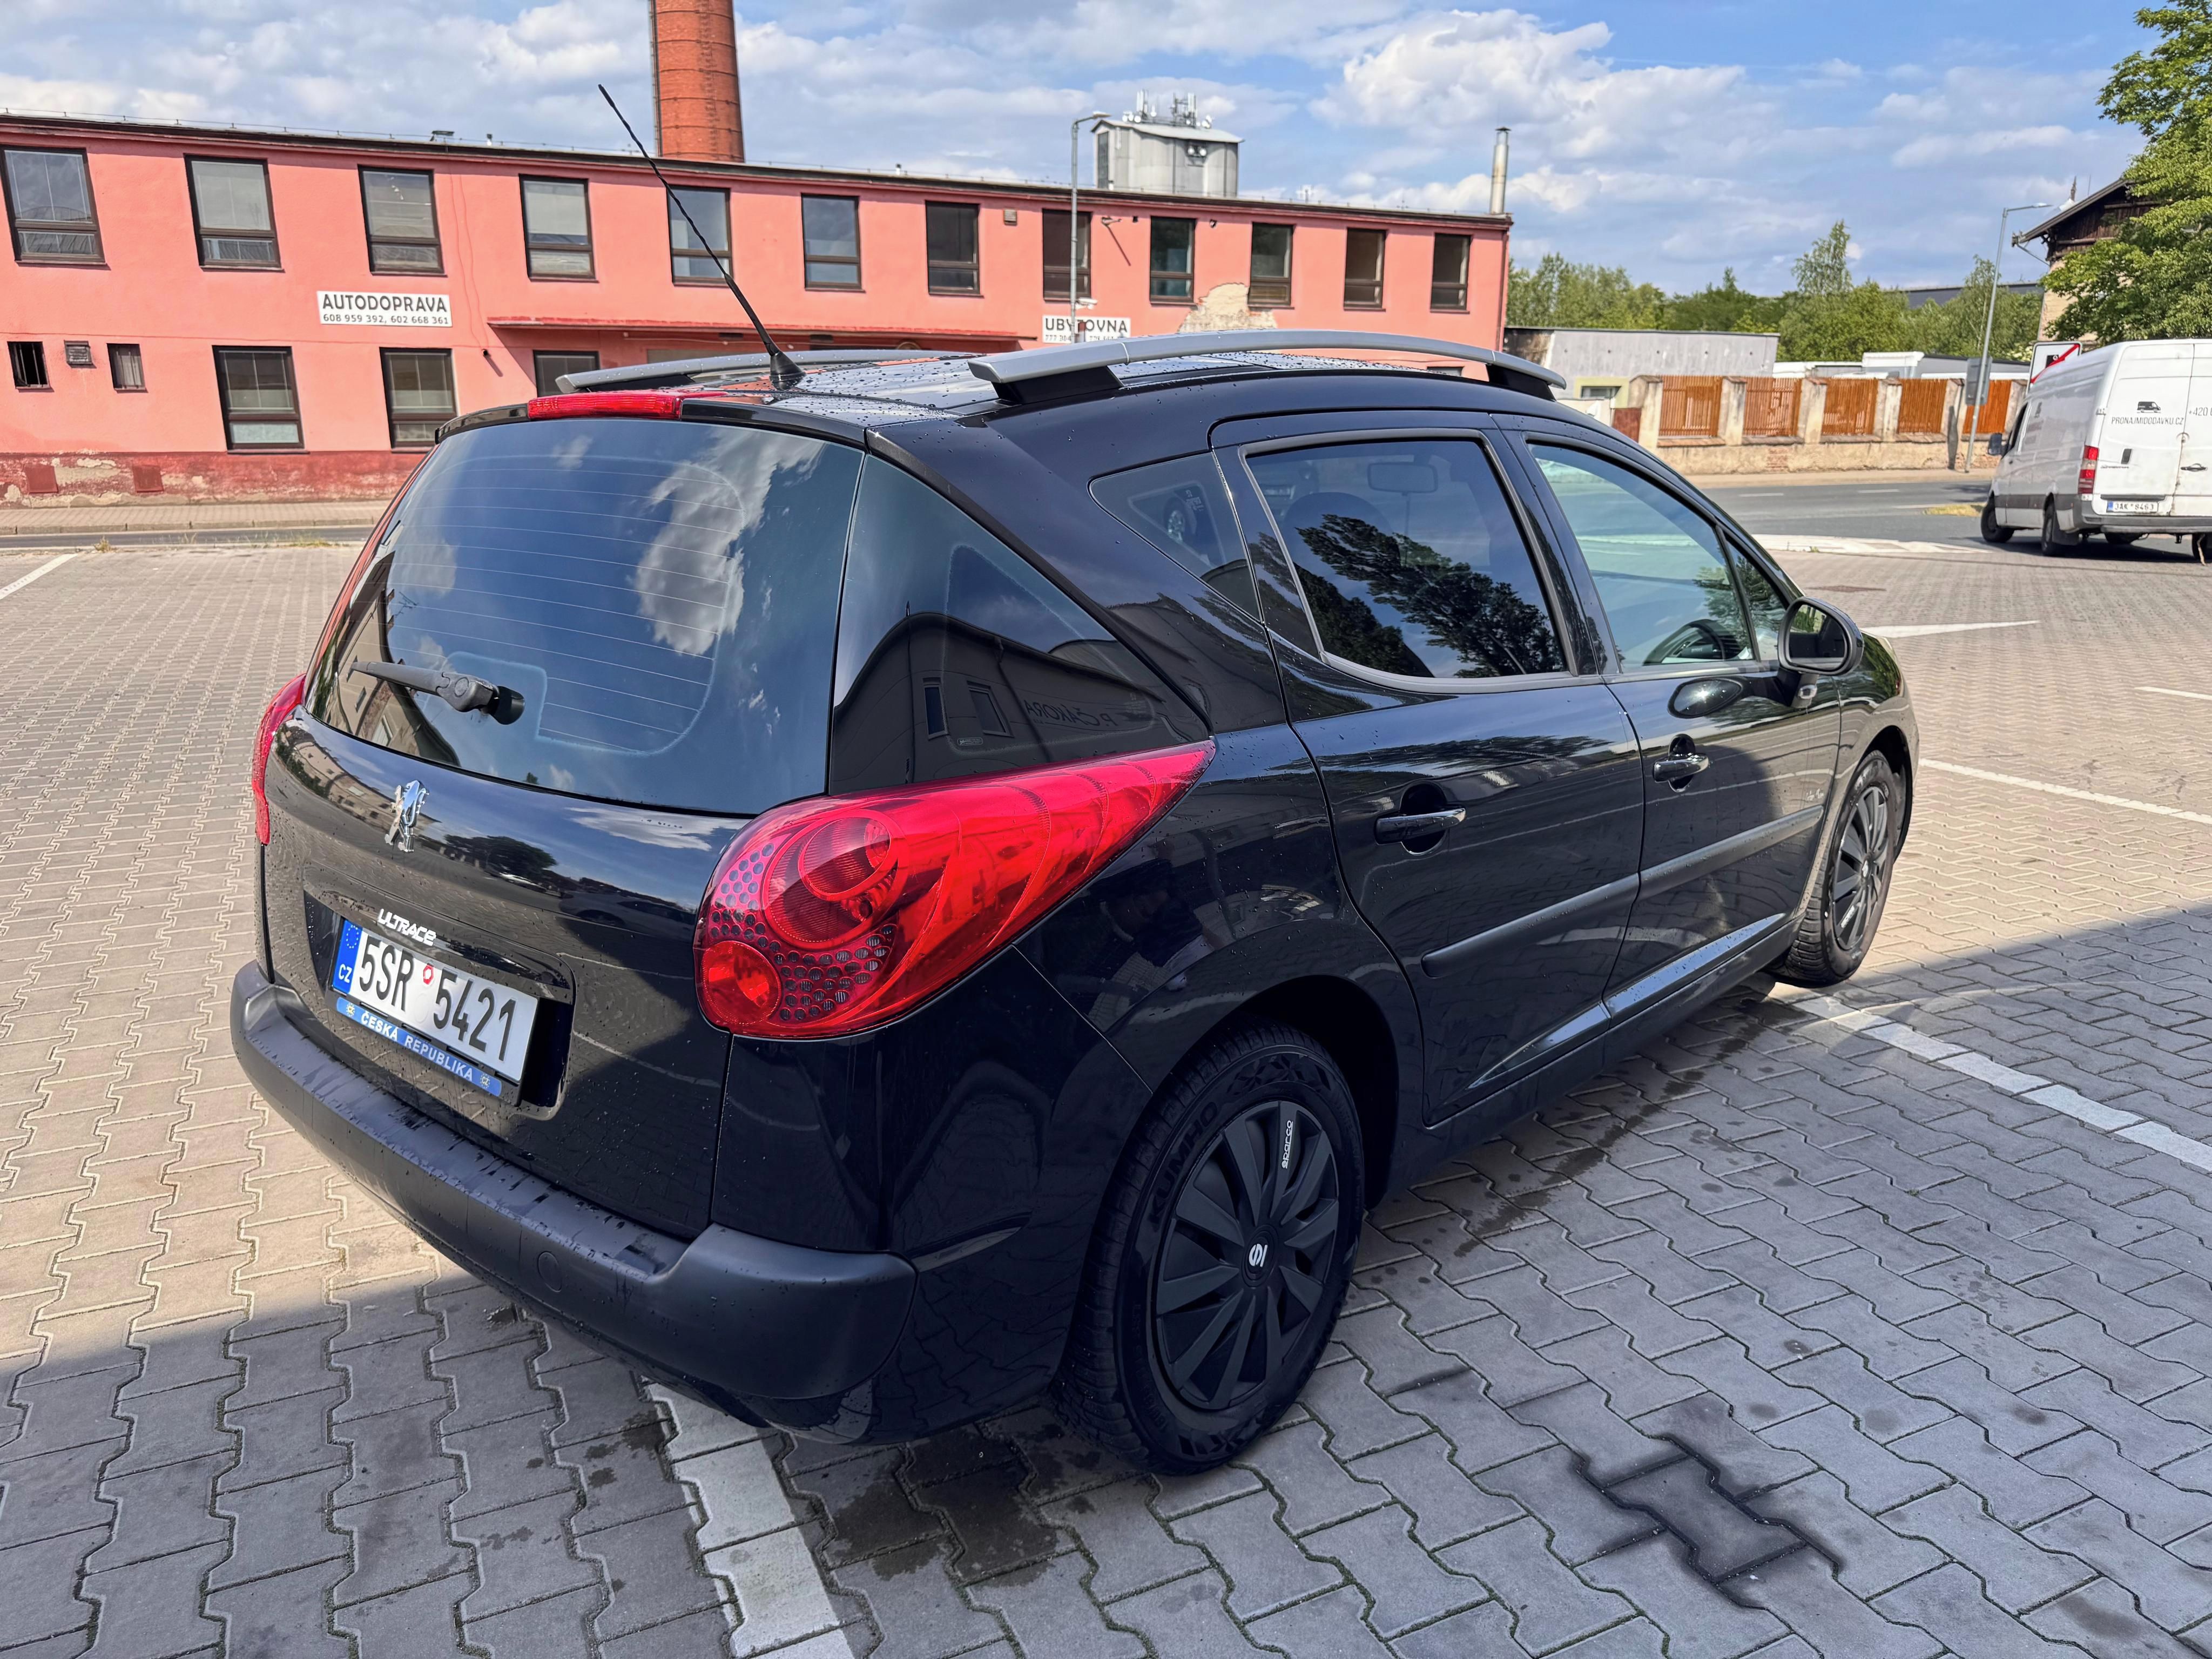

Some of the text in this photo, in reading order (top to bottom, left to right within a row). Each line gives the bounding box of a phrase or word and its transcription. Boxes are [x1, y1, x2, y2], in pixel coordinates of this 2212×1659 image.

[323, 294, 447, 312] AUTODOPRAVA
[323, 314, 341, 322] 608
[345, 314, 362, 322] 959
[366, 315, 387, 323] 392,
[2112, 416, 2184, 425] PRONAJMIDODAVKU.CZ
[339, 935, 516, 1062] CZ 5SR 5421
[361, 1010, 398, 1041] ČESKÁ
[404, 1035, 473, 1082] REPUBLIKA
